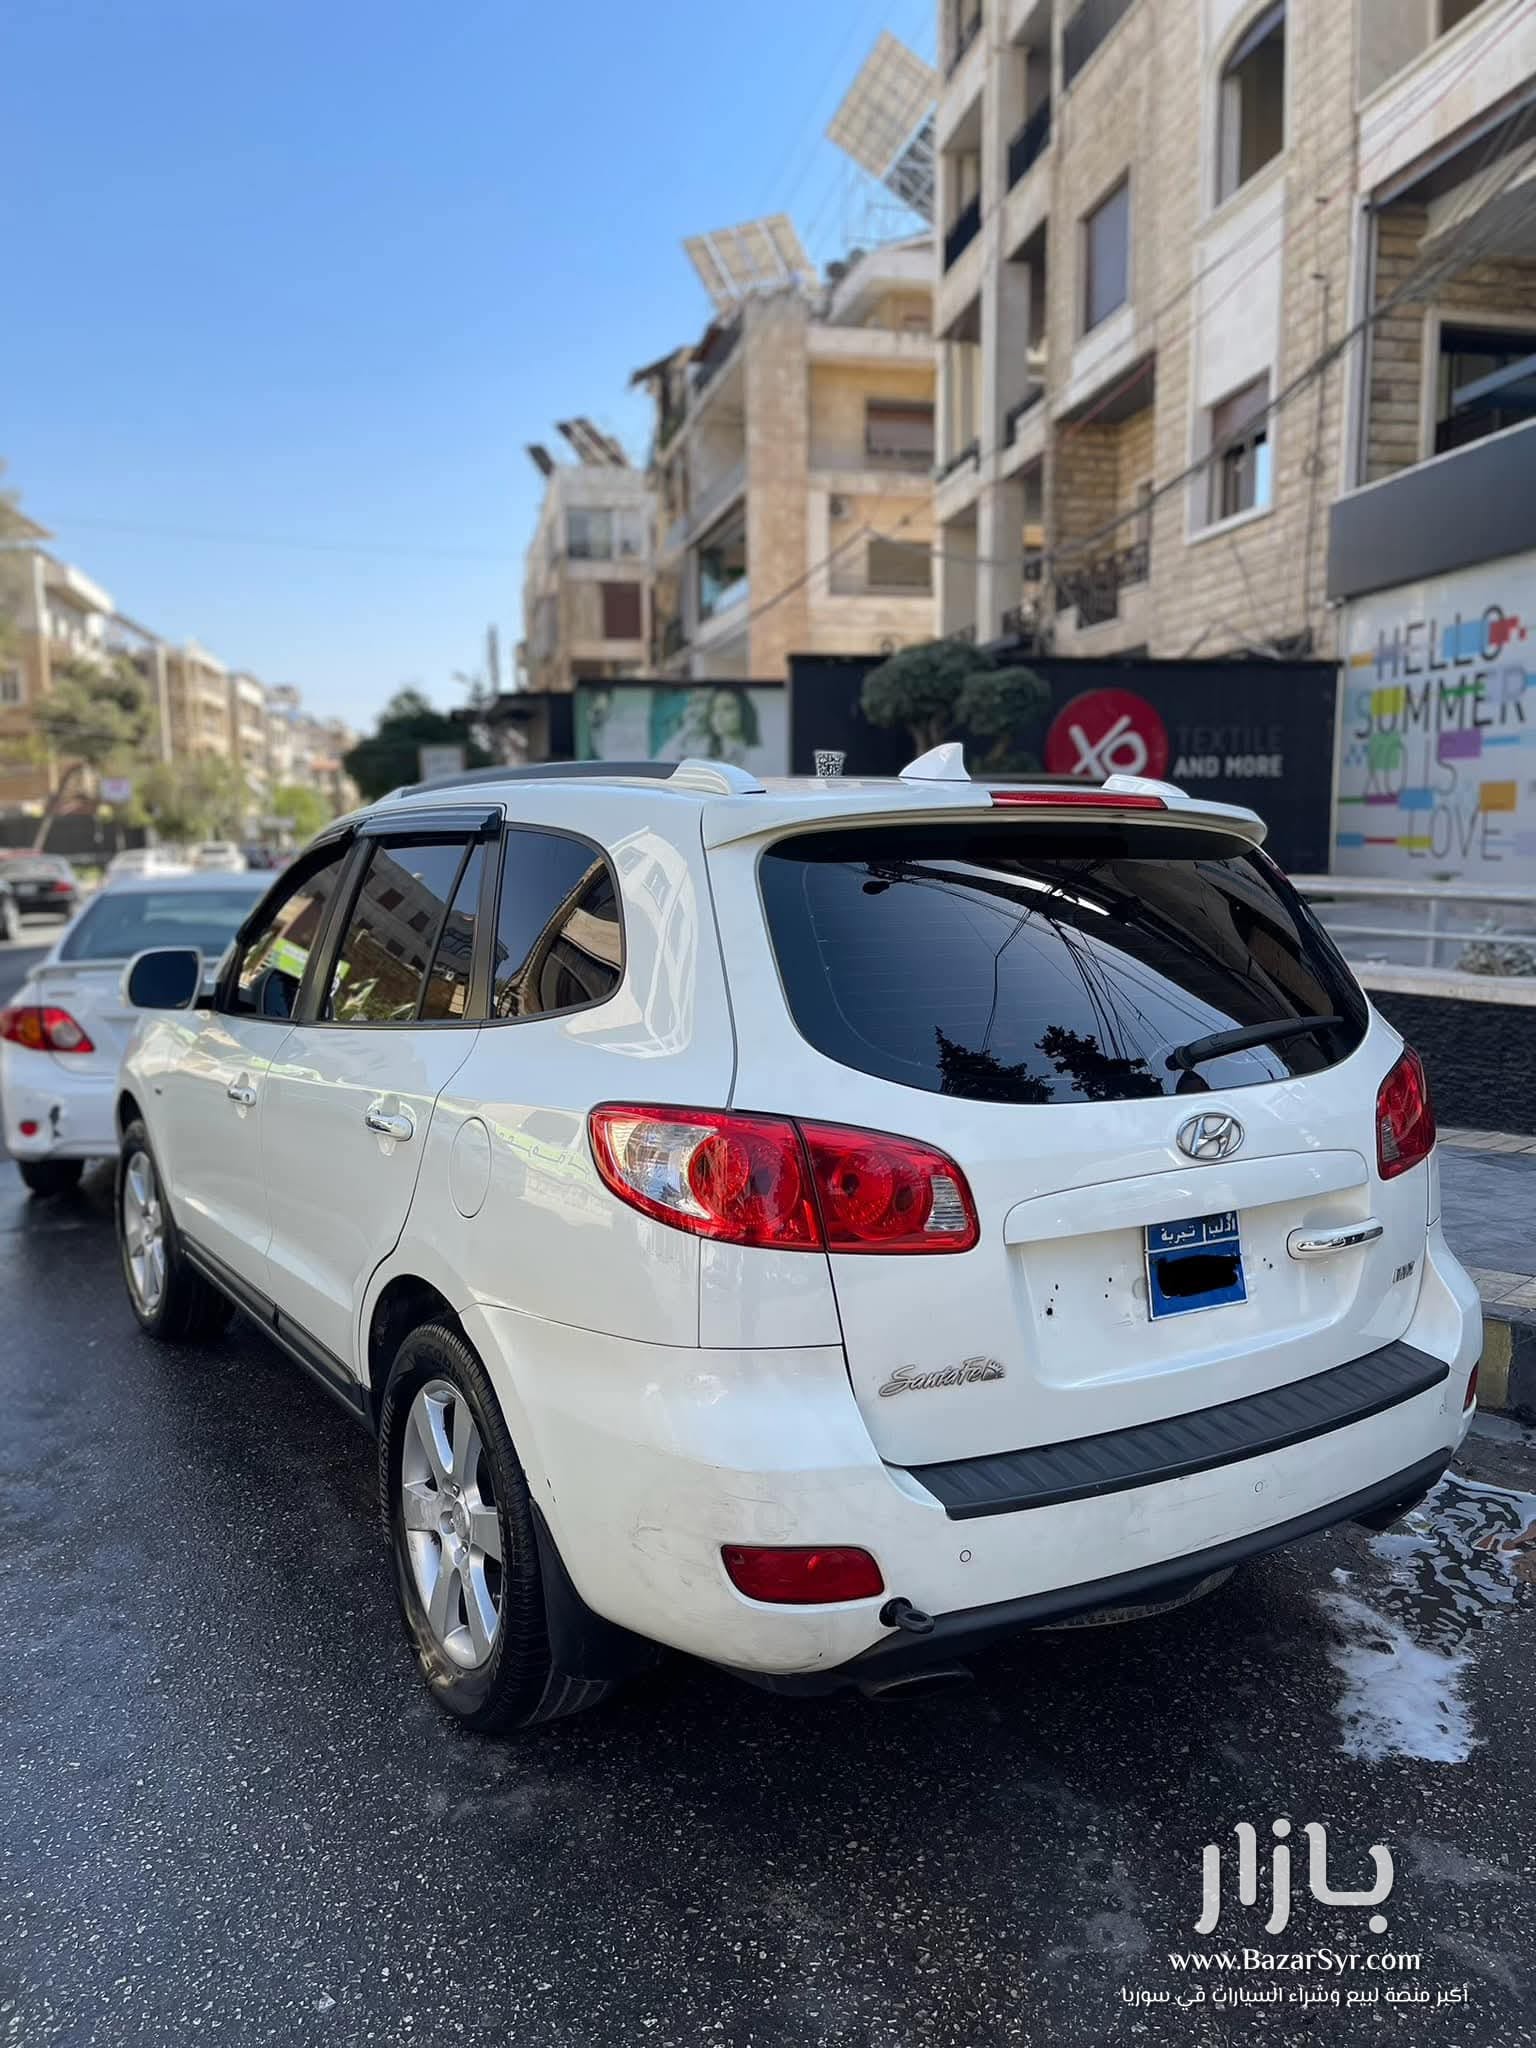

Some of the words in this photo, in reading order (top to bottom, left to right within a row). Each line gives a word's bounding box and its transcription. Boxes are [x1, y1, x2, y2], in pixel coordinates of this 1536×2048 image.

[1377, 604, 1504, 680] HELLO
[1354, 664, 1527, 739] SUMMER
[1068, 714, 1148, 780] XO
[1173, 756, 1220, 778] AND
[1226, 754, 1284, 778] MORE
[1176, 726, 1283, 751] TEXTILE
[1407, 802, 1503, 861] LOVE
[1161, 1224, 1196, 1244] تجربة
